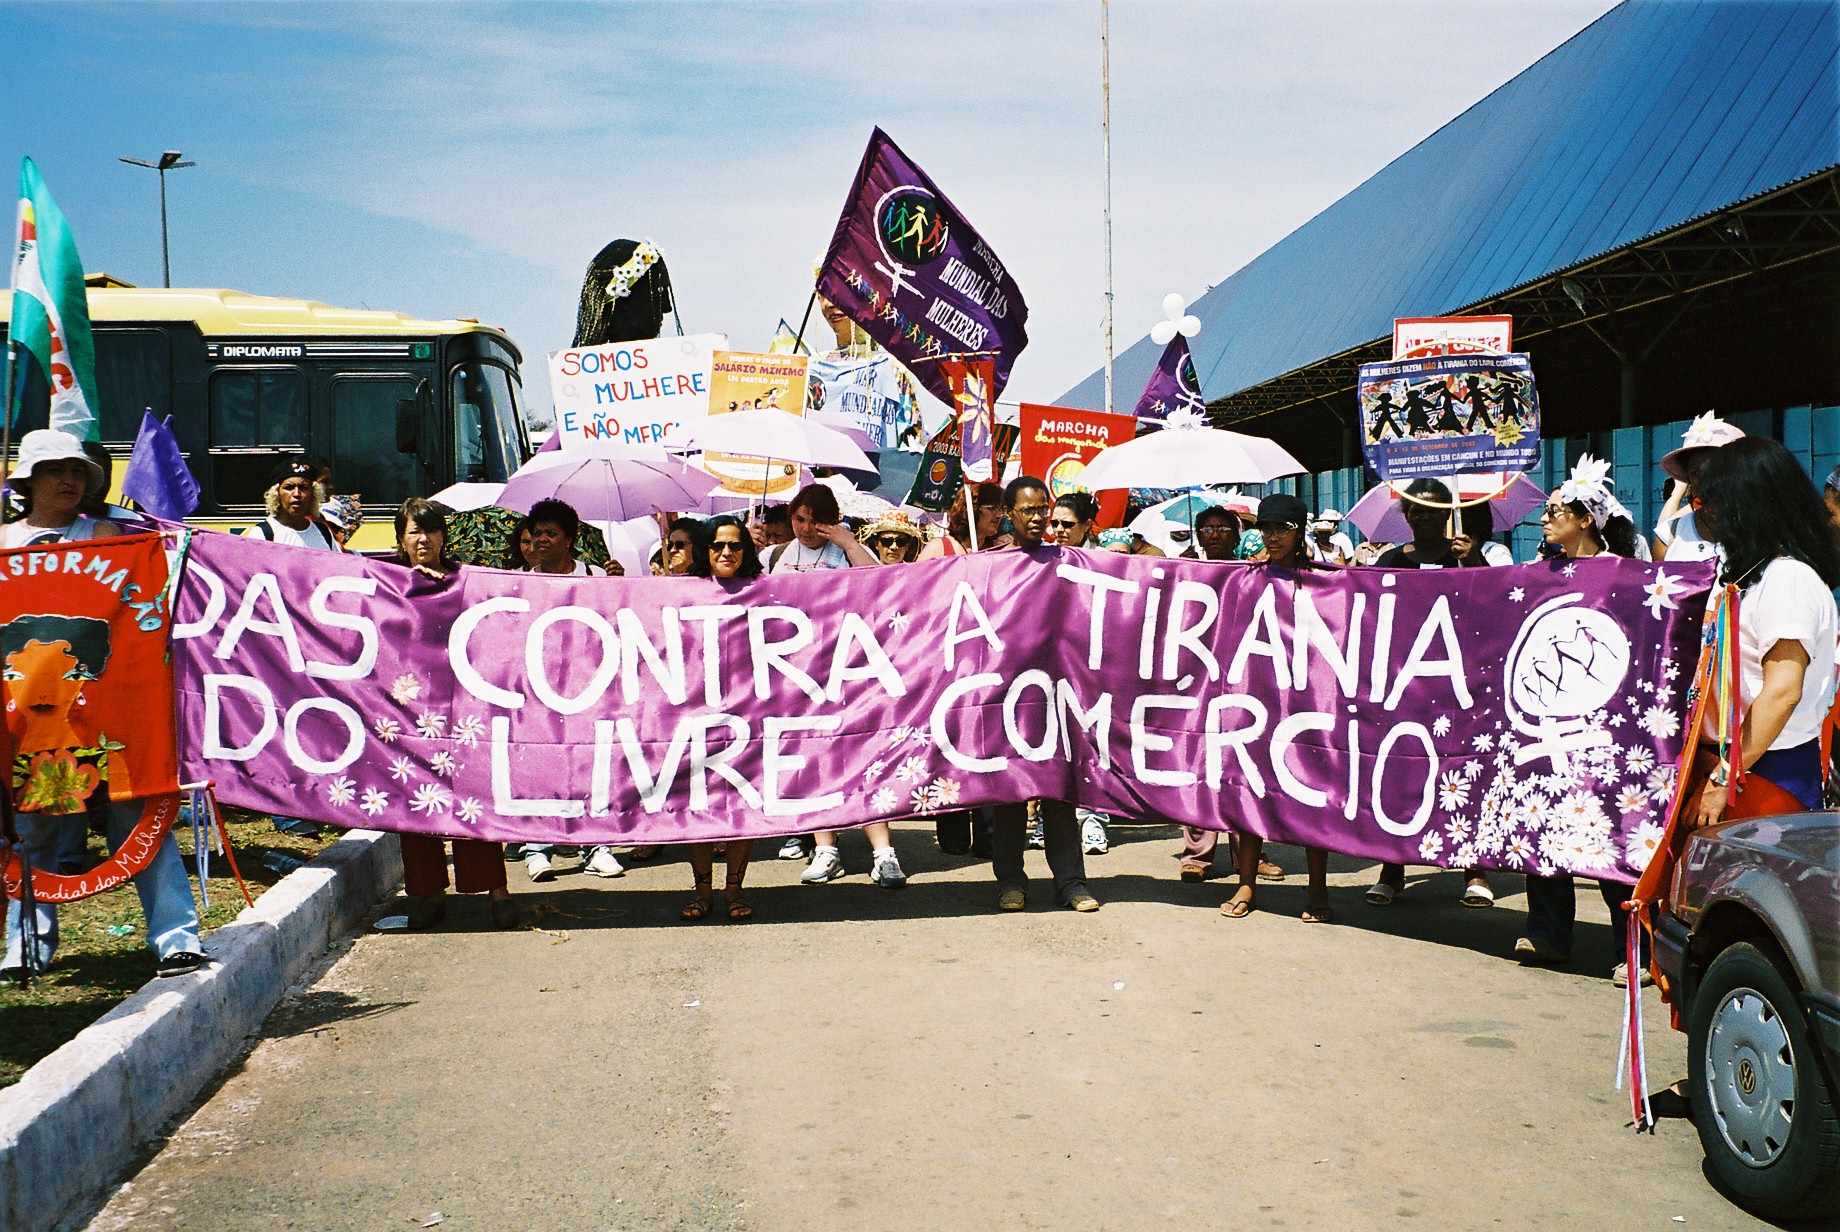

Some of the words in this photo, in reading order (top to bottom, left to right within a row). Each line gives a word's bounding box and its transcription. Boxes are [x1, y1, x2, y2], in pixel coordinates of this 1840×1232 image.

[972, 238, 1004, 284] MARCHA
[938, 256, 991, 306] MUNDIAL
[984, 287, 1008, 319] DAS
[925, 296, 989, 351] MULHERES
[223, 346, 301, 357] DIPLOMATA
[561, 348, 648, 376] SOMOS
[714, 361, 756, 374] SALÁRIO
[760, 364, 805, 377] MÍNIMO
[1370, 366, 1401, 376] MULHERES
[1402, 364, 1422, 373] DIZEM
[1469, 359, 1478, 367] DO
[770, 377, 789, 386] ANOS
[840, 392, 884, 417] MUNDAL
[564, 412, 578, 432] E
[583, 411, 620, 440] NÃO
[624, 422, 679, 444] MERC
[1035, 428, 1055, 443] das
[1041, 419, 1109, 439] MARCHA
[932, 441, 948, 454] 2003
[1388, 454, 1440, 466] MANIFESTAÇÕES
[1441, 453, 1451, 462] EM
[1485, 450, 1494, 458] NO
[1496, 449, 1519, 457] MUNDO
[449, 597, 906, 716] CONTRA
[945, 581, 1004, 672] A
[203, 673, 366, 775] DO
[491, 714, 845, 818] LIVRE
[115, 799, 171, 882] Mulheres
